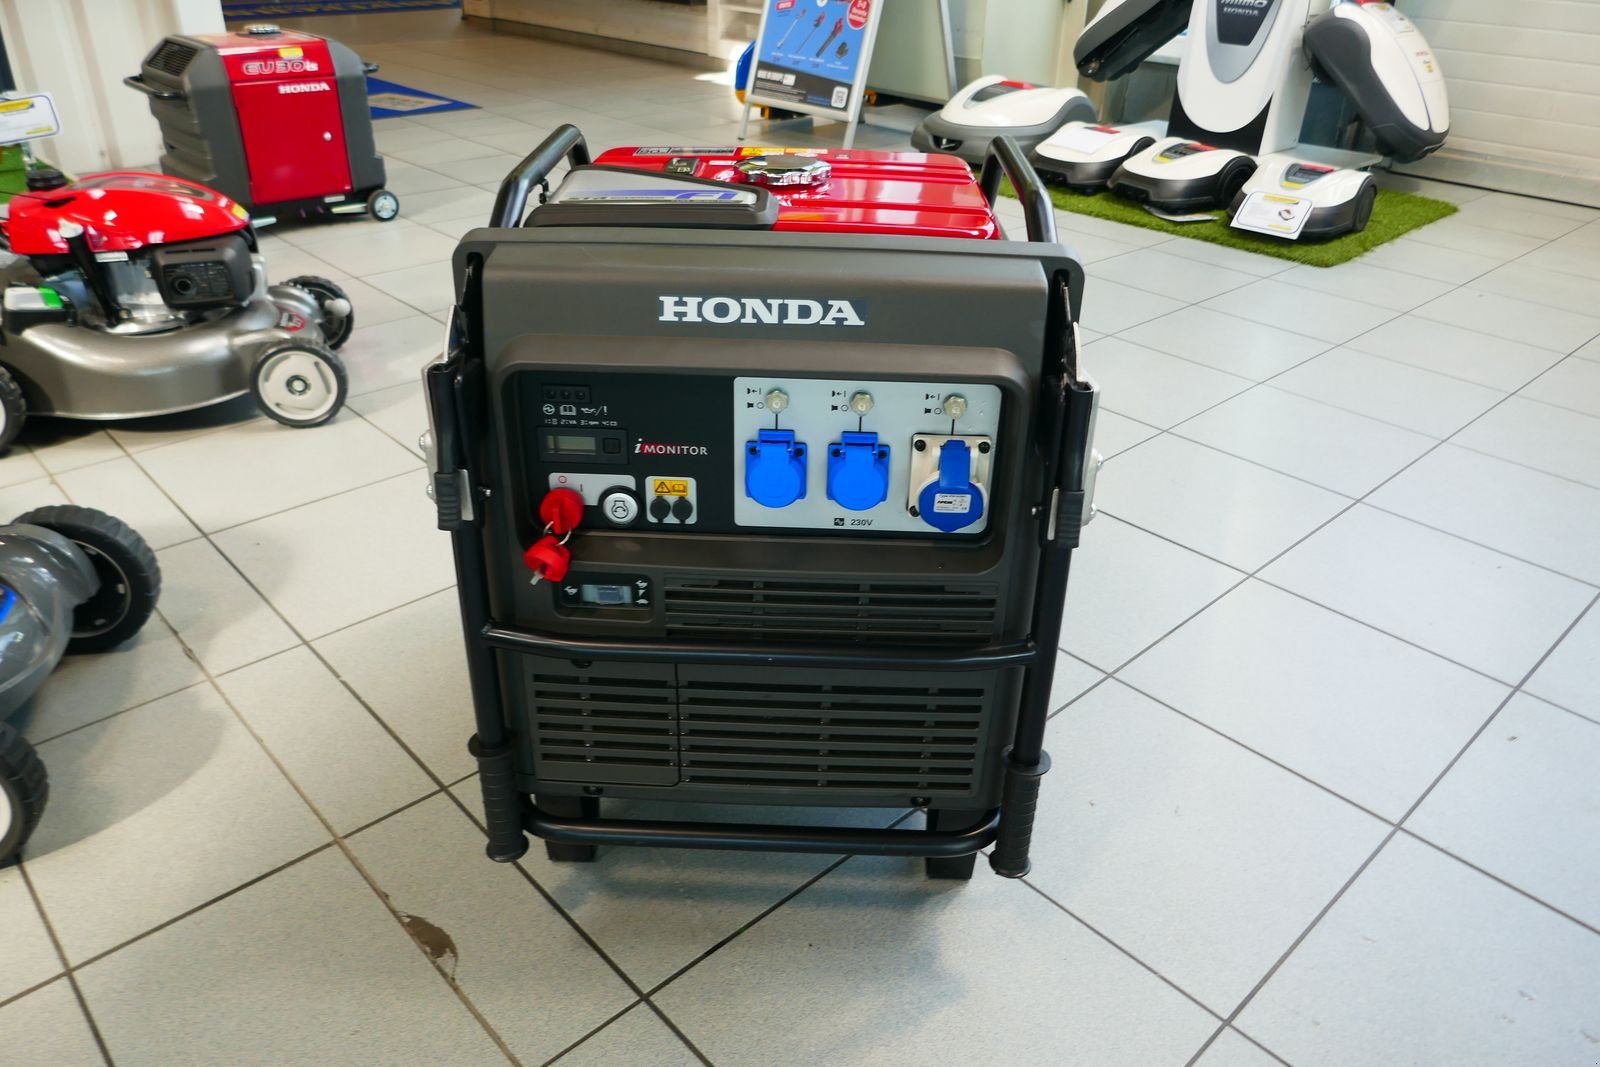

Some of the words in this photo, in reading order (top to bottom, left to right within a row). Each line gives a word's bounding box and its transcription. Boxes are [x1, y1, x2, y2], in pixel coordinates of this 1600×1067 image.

[1223, 6, 1259, 16] HONDA
[278, 82, 331, 94] HONDA
[658, 296, 865, 326] HONDA
[850, 518, 874, 526] 230V
